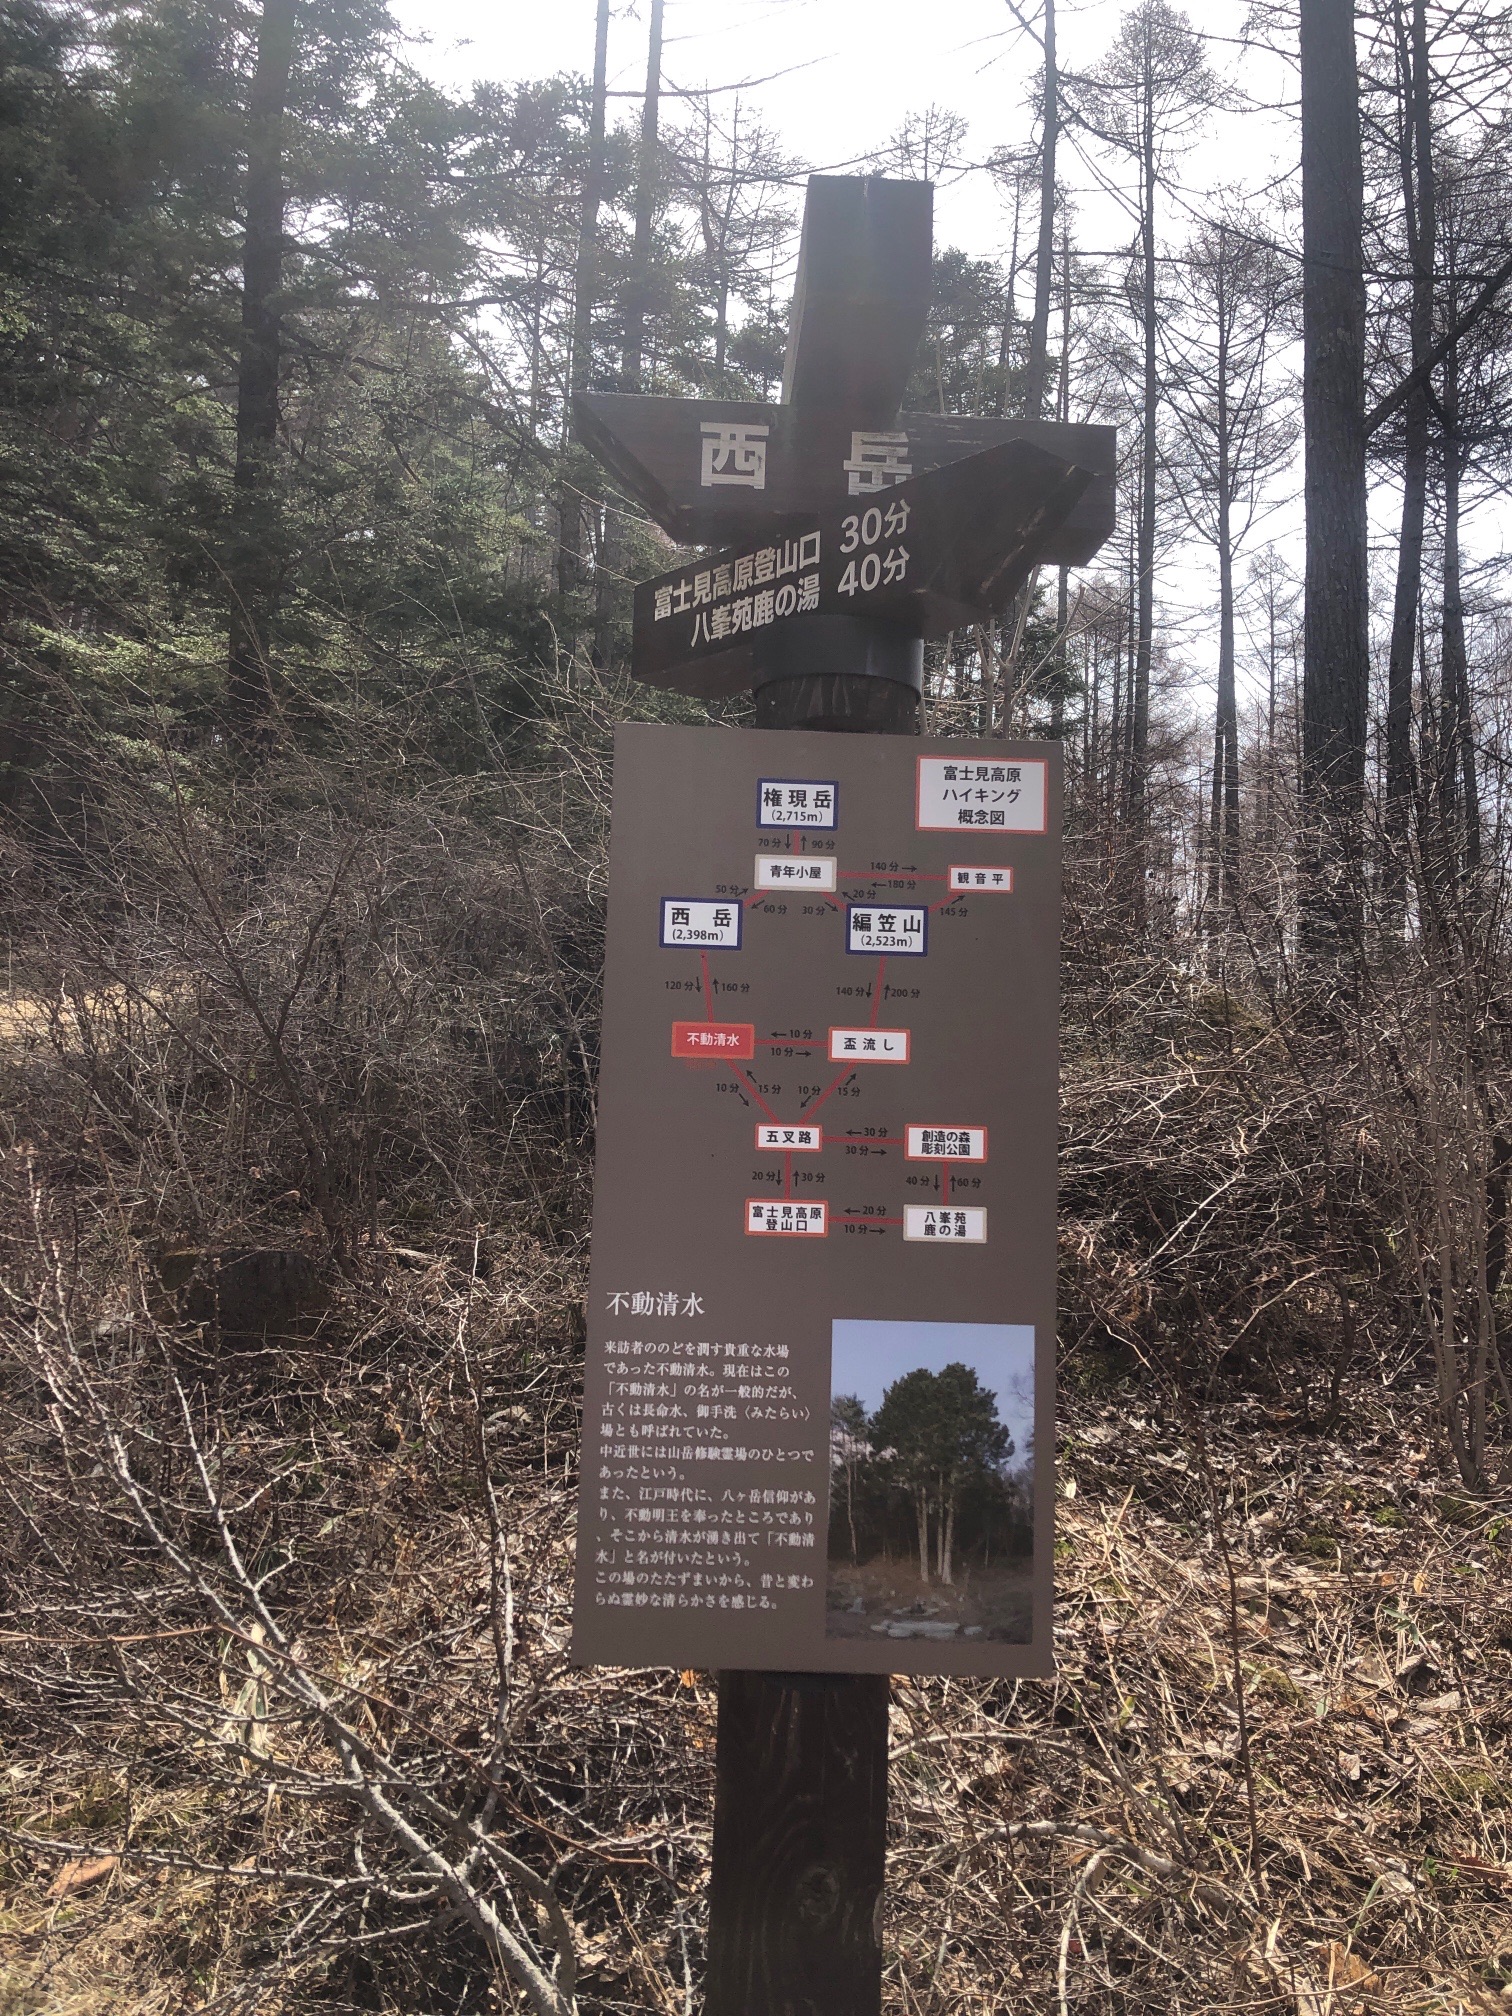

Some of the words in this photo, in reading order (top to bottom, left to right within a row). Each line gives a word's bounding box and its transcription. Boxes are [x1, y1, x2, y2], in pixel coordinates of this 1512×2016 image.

[654, 531, 821, 621] 富士見高原登山口
[840, 499, 911, 554] 30分
[691, 573, 820, 647] 八峯苑鹿の湯
[838, 546, 910, 597] 40分
[943, 766, 1022, 782] 富士見高原
[764, 788, 832, 808] 権現岳
[943, 788, 1021, 803] ハイキング
[958, 809, 1005, 825] 概念図
[770, 865, 821, 879] 青年小屋
[957, 872, 1004, 885] 観音平
[852, 914, 921, 933] 編笠山
[686, 1033, 739, 1046] 不動清水
[844, 1038, 894, 1051] 盃流し
[766, 1131, 812, 1144] 五叉路
[921, 1131, 971, 1143] 創造の森
[921, 1143, 971, 1156] 彫刻公園
[752, 1206, 822, 1220] 富士見高原
[766, 1219, 808, 1232] 登山口
[924, 1224, 967, 1237] 鹿の湯
[605, 1291, 705, 1317] 不動清水
[604, 1340, 789, 1358] 来訪者ののどを潤す貴重な水場
[604, 1362, 789, 1377] であった不動清水。現在はこの
[608, 1381, 797, 1399] 「不動清水」の名が一般的だが、
[601, 1424, 729, 1440] 場とも呼ばれていた。
[600, 1445, 814, 1462] 中近世には山岳修験霊場のひとつで
[600, 1466, 685, 1480] あったという。
[596, 1550, 749, 1566] 水」と名が付いたという。
[596, 1571, 814, 1589] この場のたたずまいから、昔と変わ
